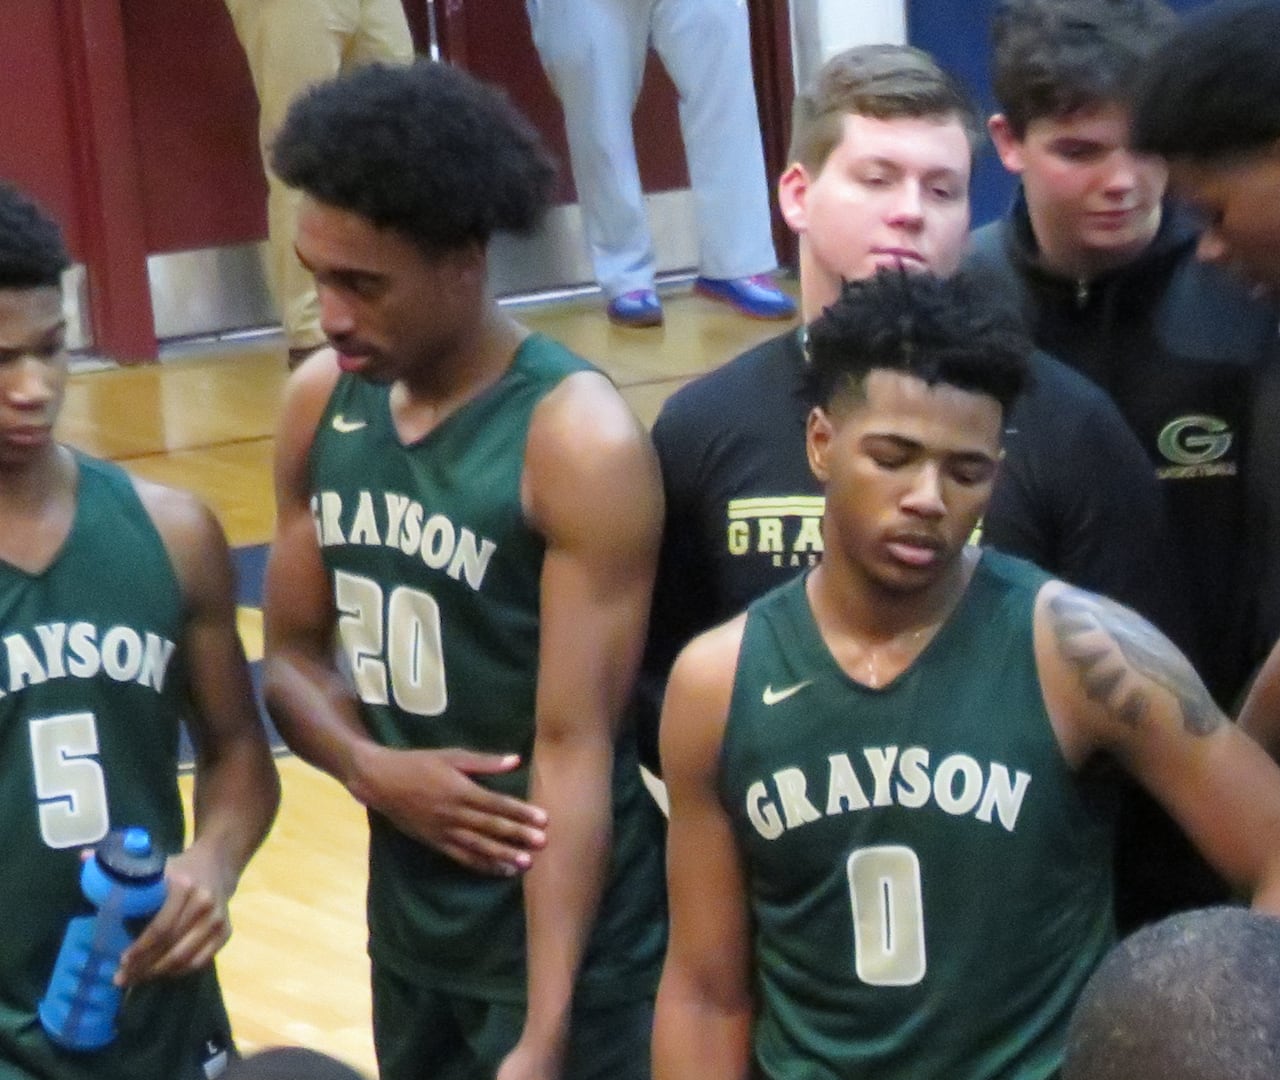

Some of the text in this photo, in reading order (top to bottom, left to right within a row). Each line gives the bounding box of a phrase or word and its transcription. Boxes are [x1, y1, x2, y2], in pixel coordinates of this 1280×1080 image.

[1157, 415, 1233, 465] G
[728, 517, 824, 555] GRA
[0, 621, 177, 694] AYSON
[335, 568, 448, 716] 20
[28, 712, 109, 849] 5
[747, 746, 1032, 840] GRAYSON
[847, 845, 926, 987] 0
